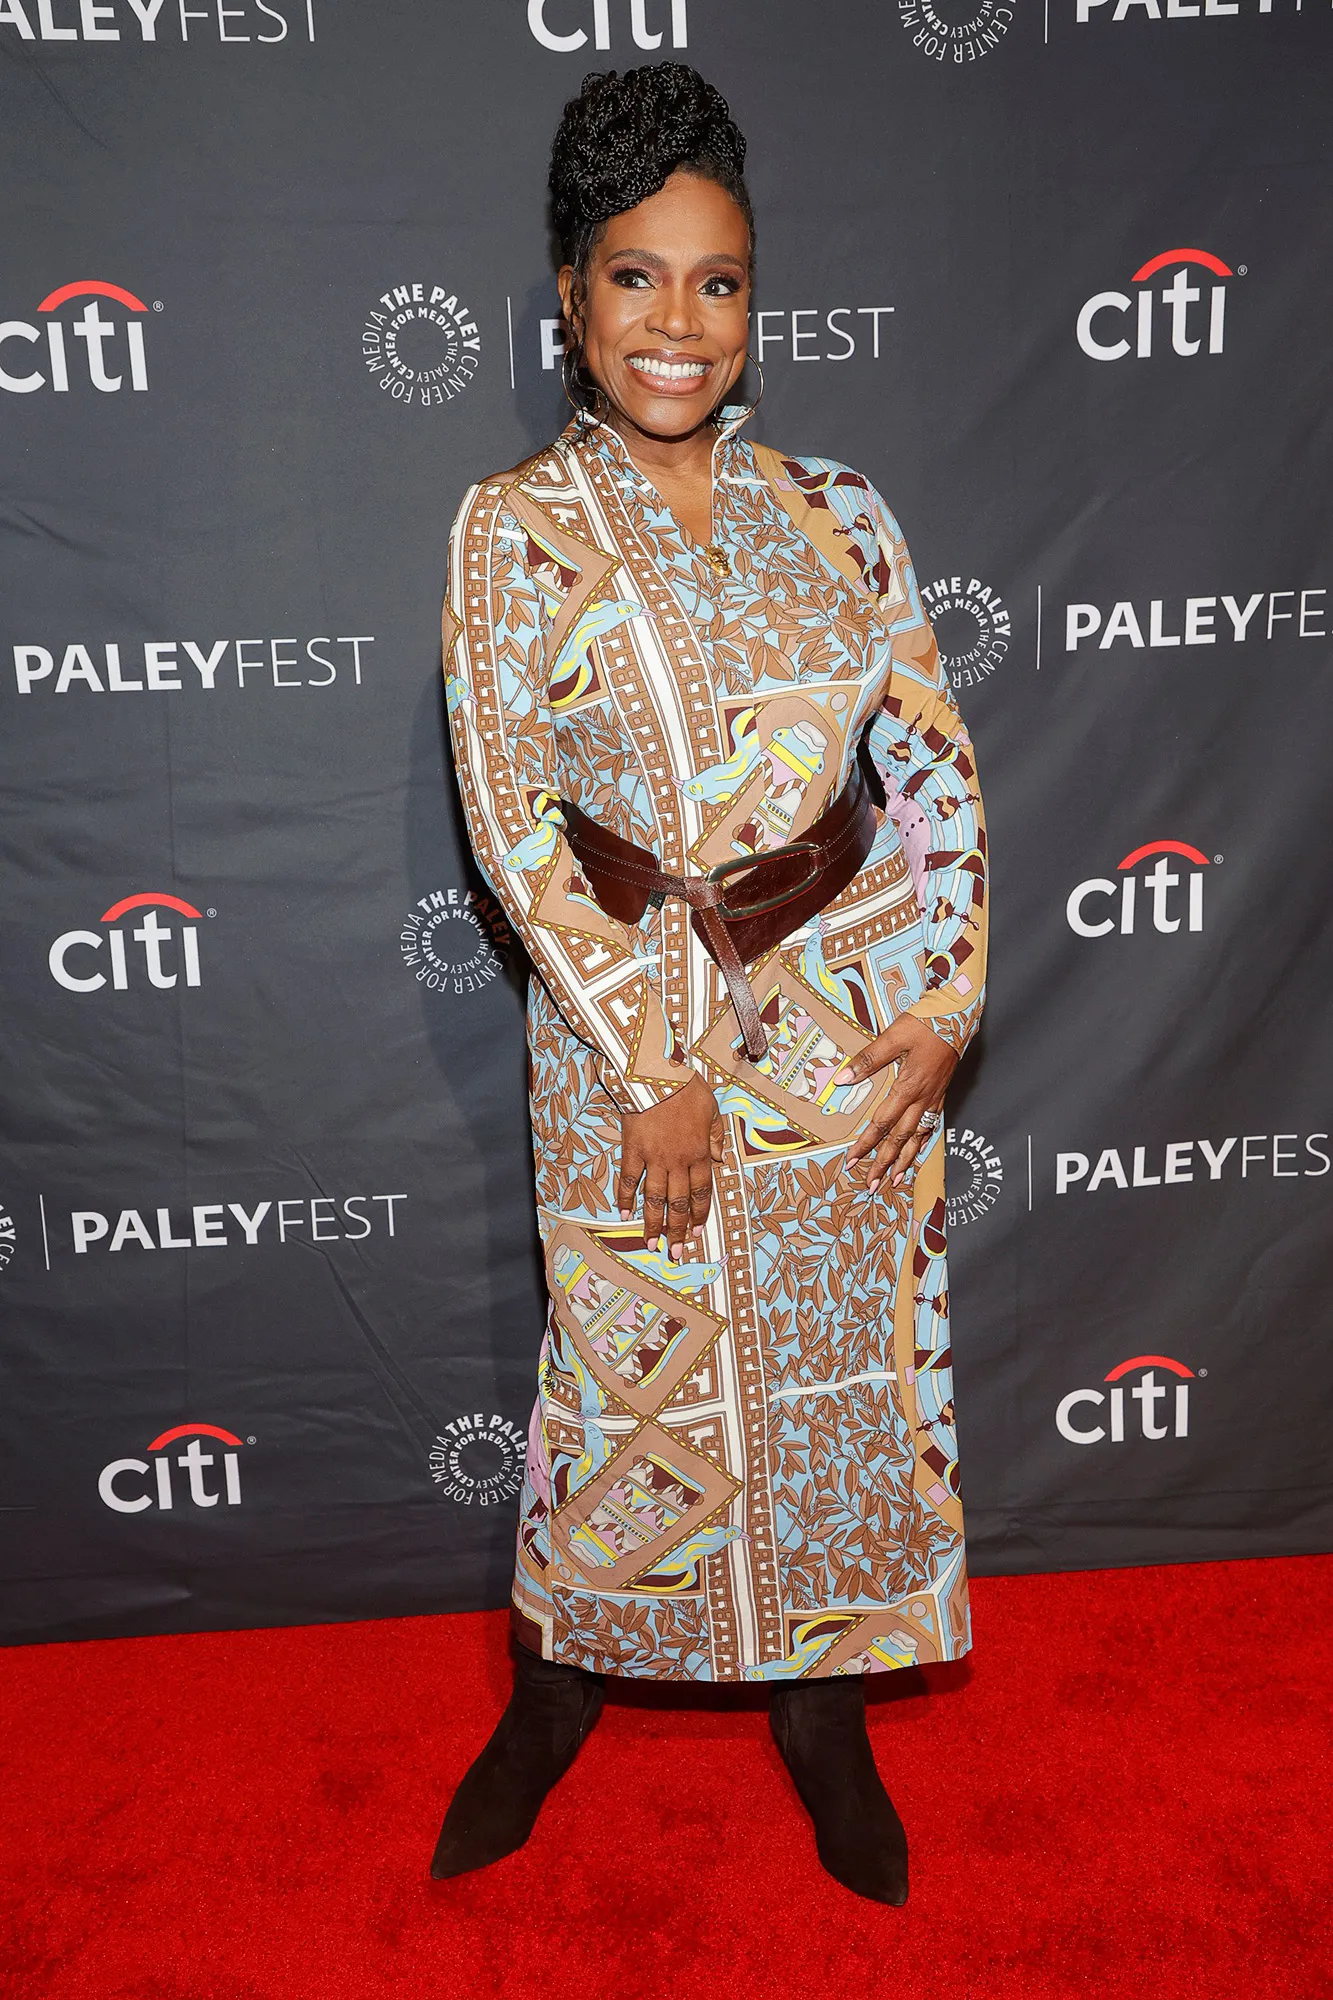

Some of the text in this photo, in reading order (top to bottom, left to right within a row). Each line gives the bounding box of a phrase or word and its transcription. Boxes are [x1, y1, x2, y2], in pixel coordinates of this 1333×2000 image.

[922, 0, 949, 35] CENT
[950, 17, 984, 38] PALEY
[953, 8, 1013, 63] CENTER
[913, 27, 947, 61] FOR
[362, 283, 481, 406] THE PALEY CENTER FOR MEDIA
[385, 307, 458, 383] THE PALEY CENTER FOR MEDIA
[921, 577, 1011, 688] THE PALEY CENTER
[929, 598, 988, 627] FOR MEDIA
[1066, 589, 1333, 651] PALEYFE
[13, 636, 375, 694] PALEYFEST
[949, 628, 990, 667] THE PALEY
[417, 889, 459, 914] THE
[400, 913, 424, 967] MEDIA
[422, 909, 489, 974] THE PALEY CENTER FOR MEDIA
[415, 965, 447, 992] FOR
[454, 949, 508, 994] CENTER
[948, 1129, 1003, 1227] PALEY CENTER
[950, 1147, 981, 1172] MEDIA
[945, 1173, 983, 1207] THE PALEY
[71, 1194, 407, 1253] PALEYFEST
[444, 1413, 484, 1436] THE
[429, 1435, 452, 1483] MEDIA
[449, 1431, 513, 1488] THE PALEY CENTER FOR MEDIA
[443, 1482, 473, 1505] FOR
